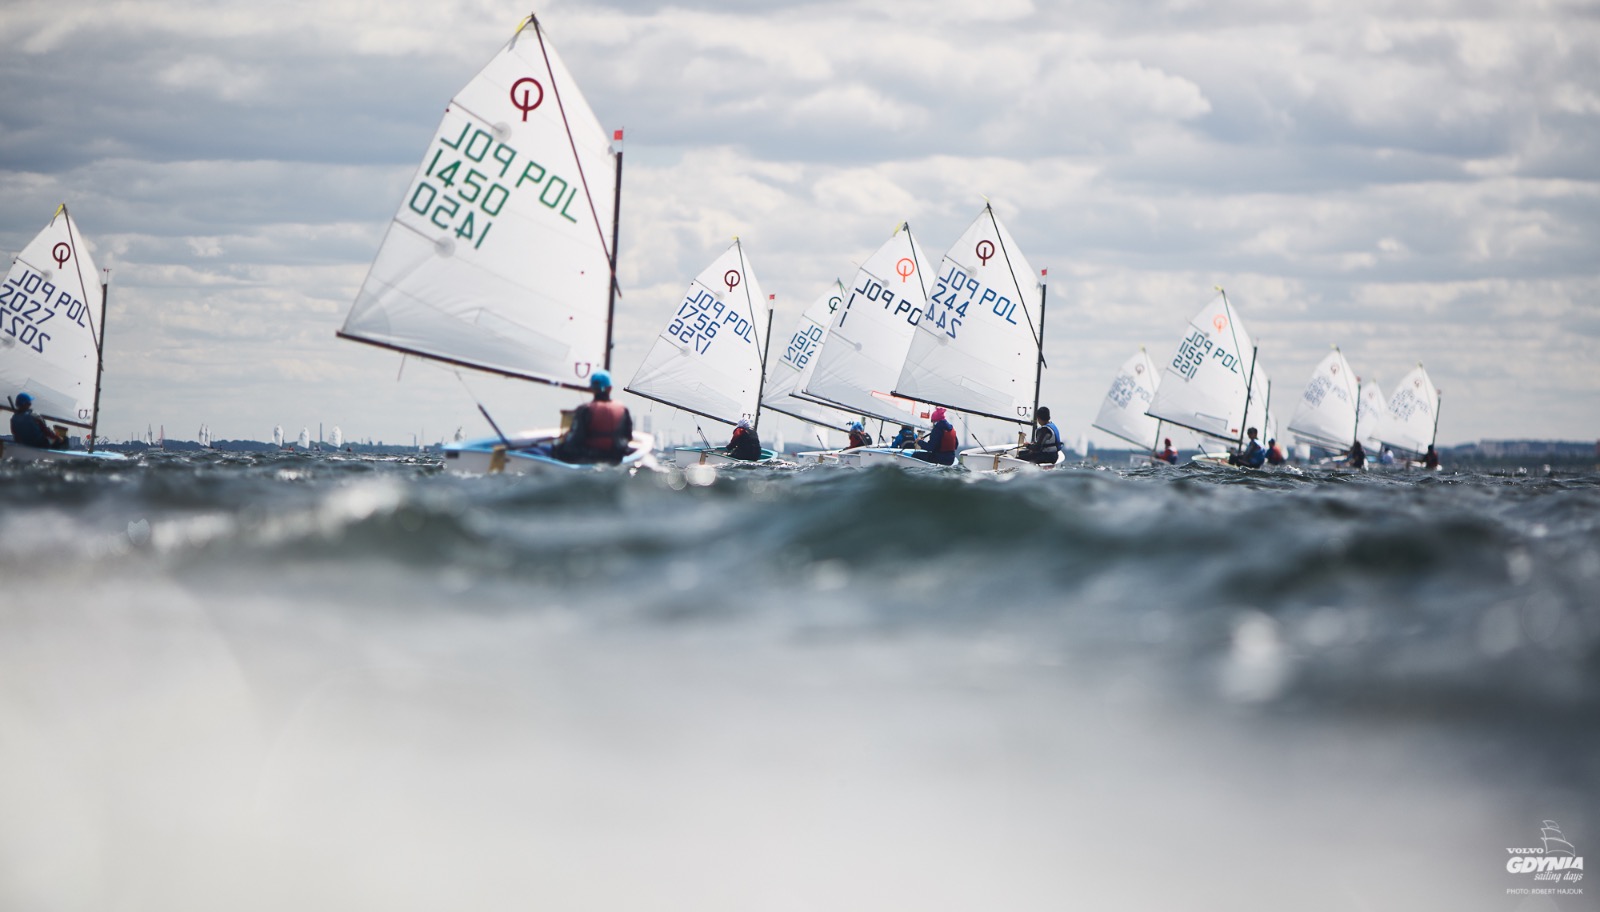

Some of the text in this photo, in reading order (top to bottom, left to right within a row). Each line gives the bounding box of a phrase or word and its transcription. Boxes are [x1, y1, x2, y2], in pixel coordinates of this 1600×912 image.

[425, 148, 510, 217] 1450
[515, 160, 578, 224] POL
[0, 284, 55, 325] 2027
[54, 291, 86, 328] POL
[894, 299, 922, 326] PO
[931, 283, 970, 318] 244
[978, 288, 1017, 325] POL
[678, 302, 720, 338] 1756
[723, 311, 752, 344] POL
[1179, 341, 1204, 366] 1155
[1212, 348, 1239, 374] POL
